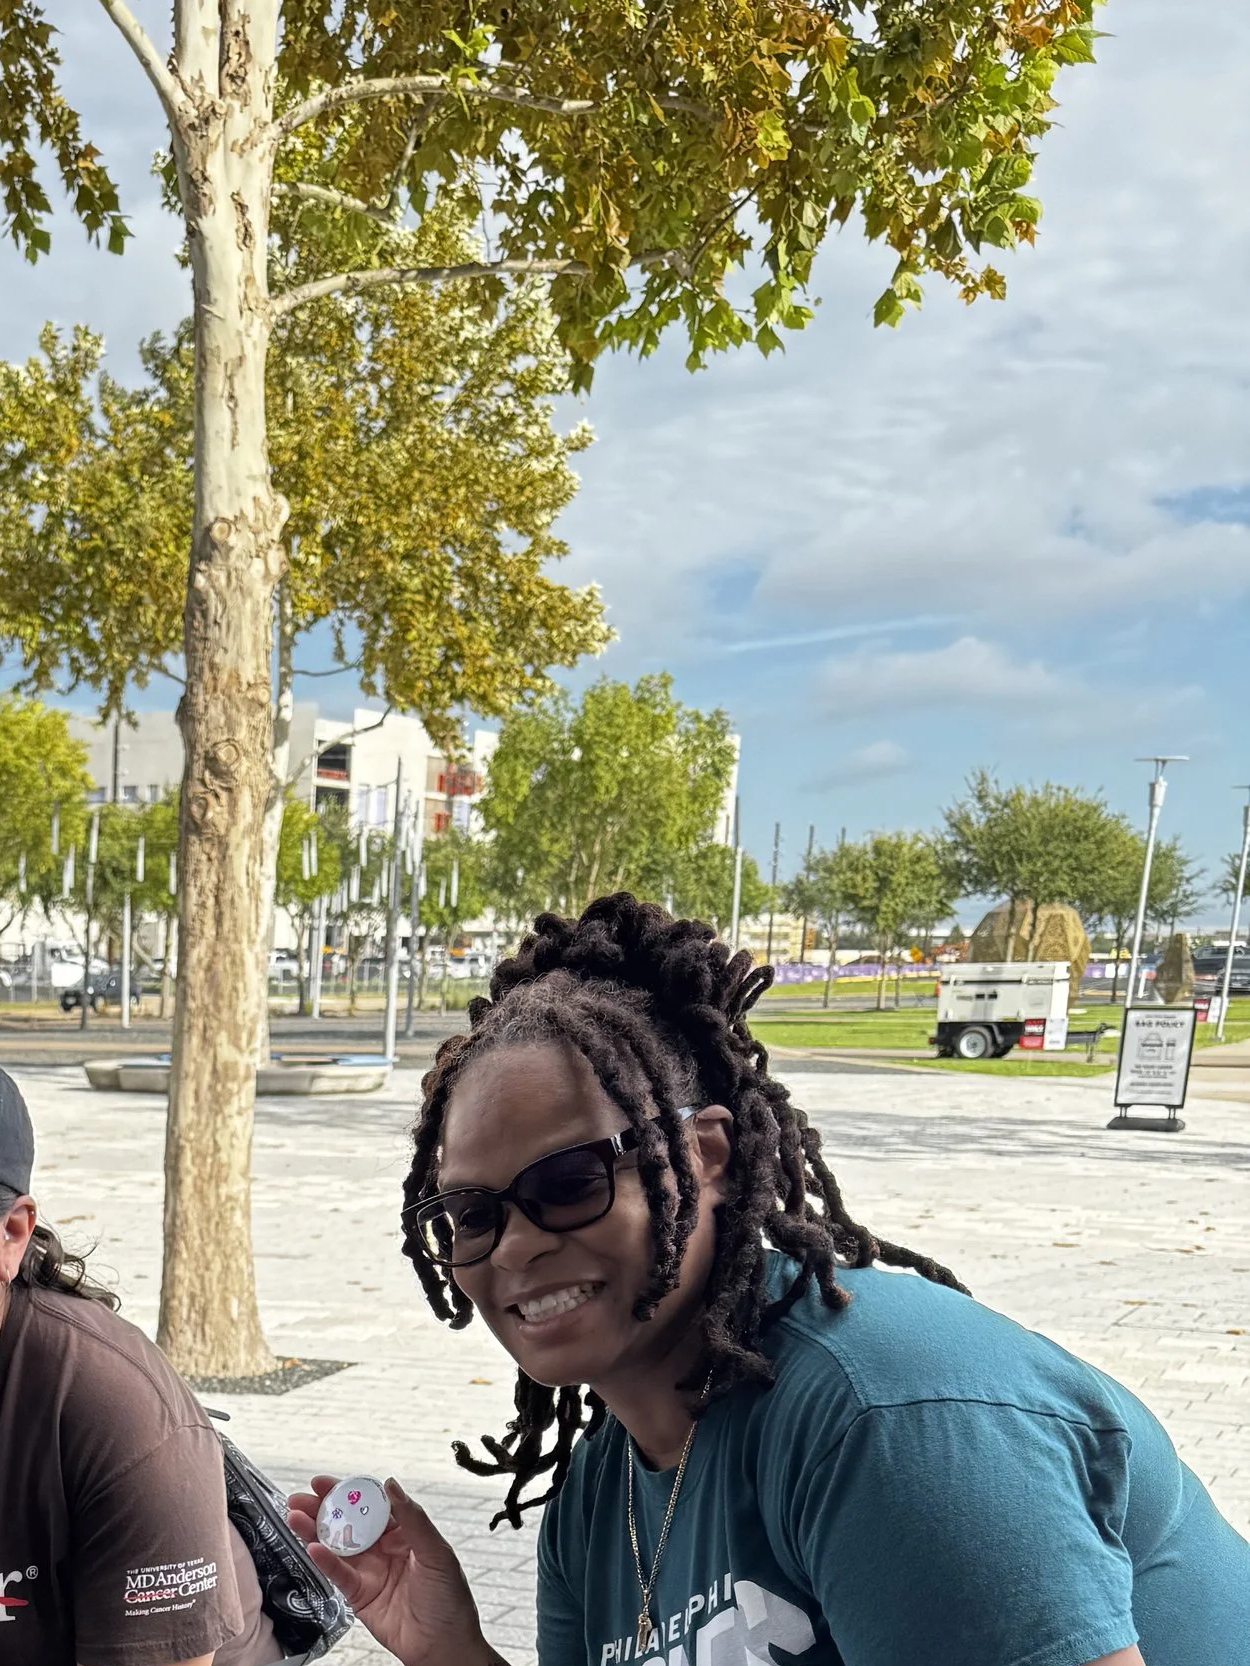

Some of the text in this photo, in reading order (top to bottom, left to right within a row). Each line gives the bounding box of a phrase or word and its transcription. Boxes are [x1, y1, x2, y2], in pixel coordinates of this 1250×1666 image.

[125, 1562, 217, 1590] MD Anderson
[140, 1563, 176, 1574] UNIVERSITY
[187, 1557, 204, 1566] TEXAS
[124, 1575, 218, 1604] Cancer Center
[125, 1608, 149, 1617] Making
[150, 1605, 171, 1614] Cancer
